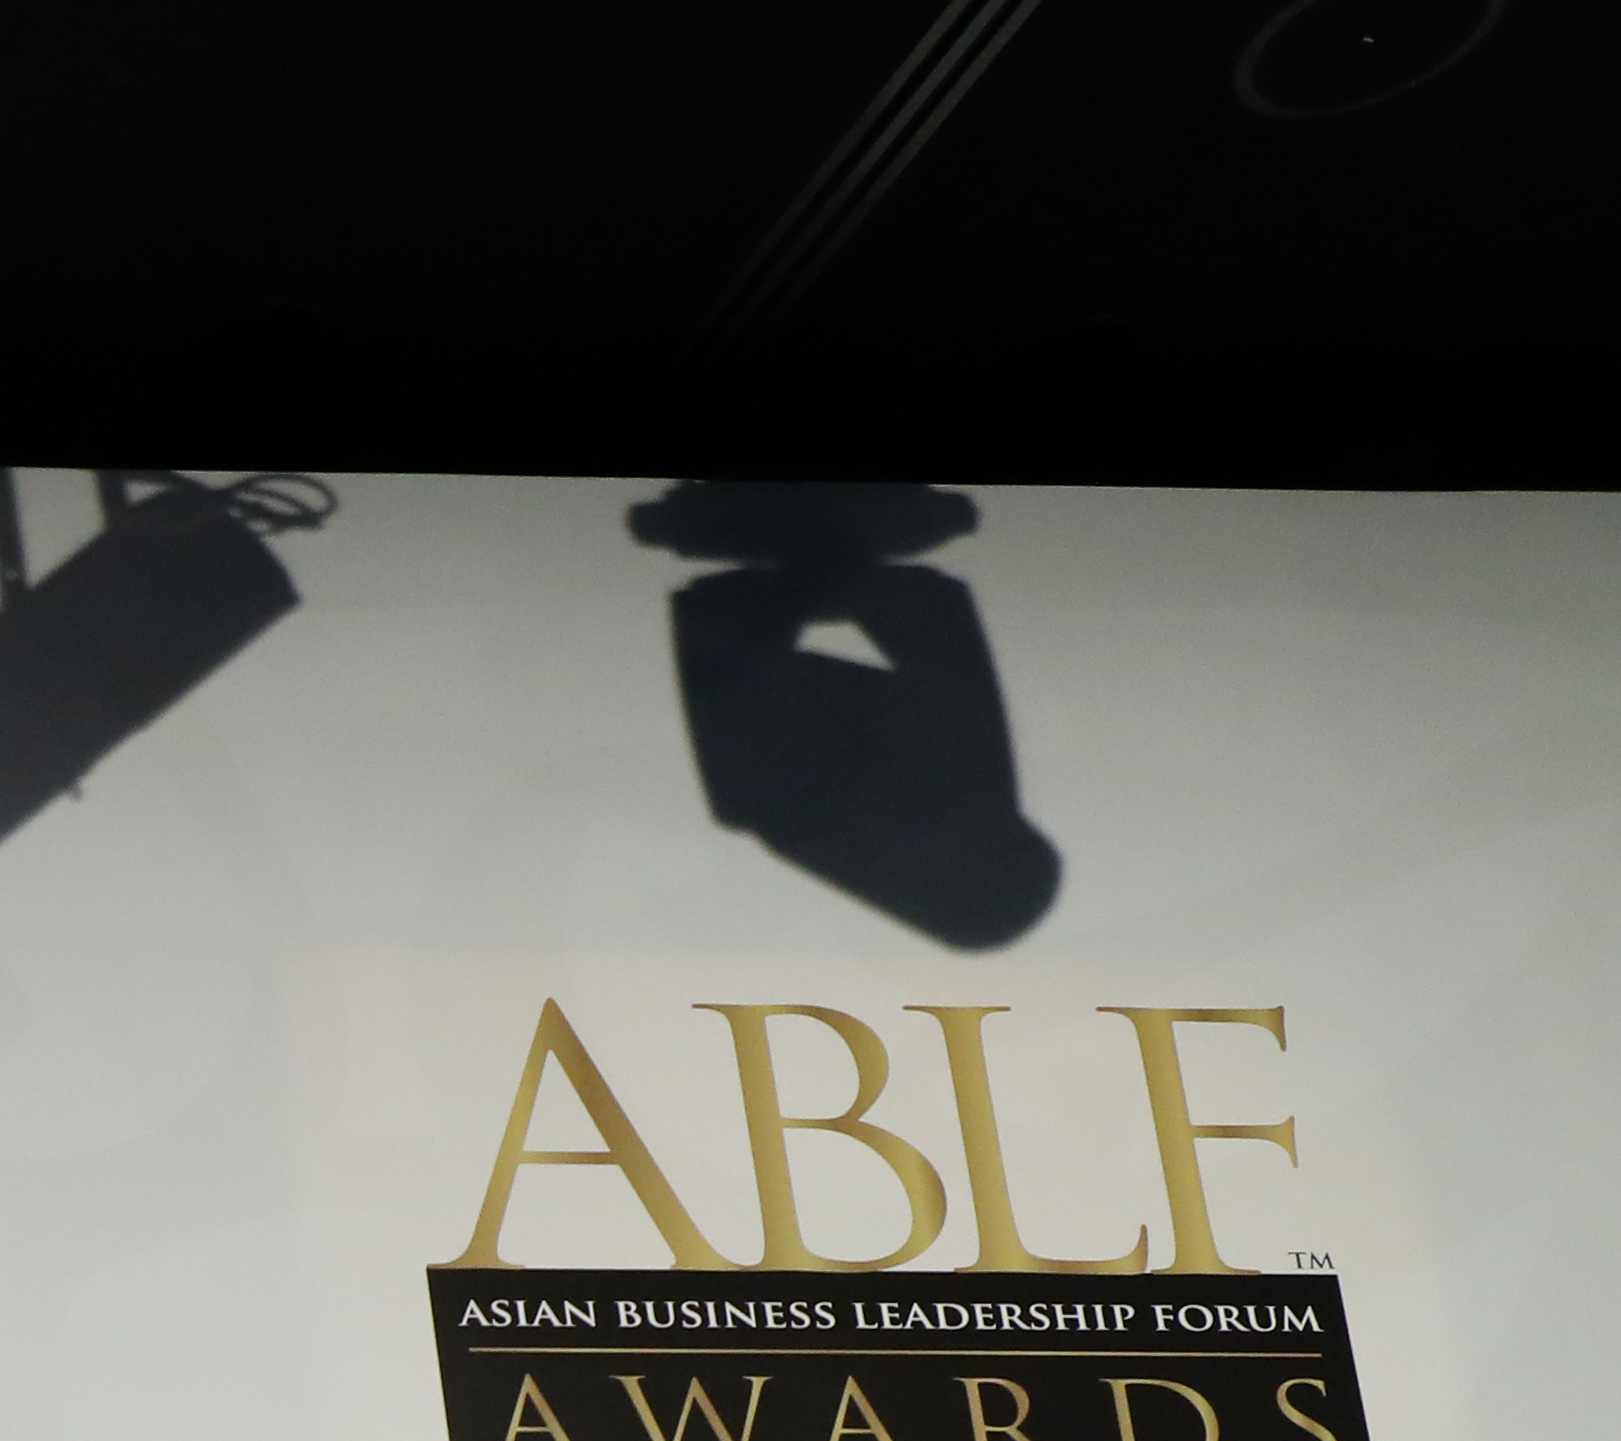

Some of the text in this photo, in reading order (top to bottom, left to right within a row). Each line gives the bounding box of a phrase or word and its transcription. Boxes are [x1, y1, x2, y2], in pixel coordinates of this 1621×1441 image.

[430, 997, 1298, 1276] ABLF
[459, 1300, 1324, 1334] ASIAN BUSINESS LEADERSHIP FORUM
